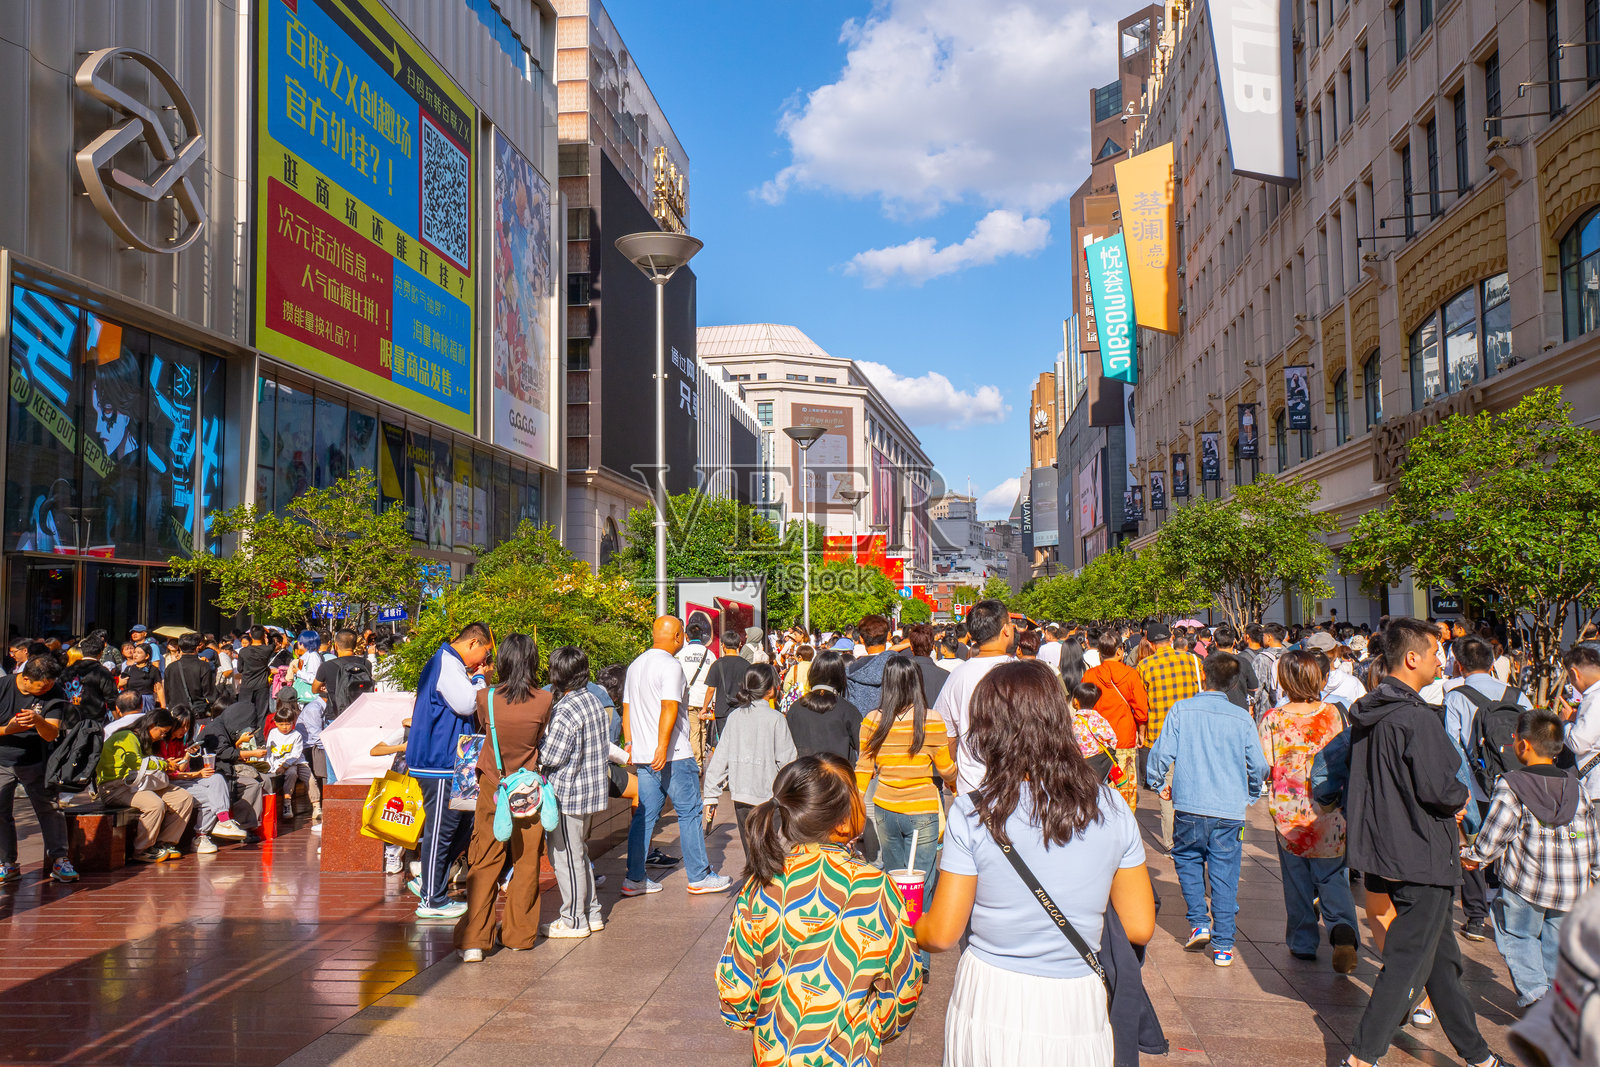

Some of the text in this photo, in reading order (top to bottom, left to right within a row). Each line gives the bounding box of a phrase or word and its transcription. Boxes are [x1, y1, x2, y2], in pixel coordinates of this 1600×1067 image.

[286, 10, 411, 159] 百联ZX创趣场
[32, 394, 76, 444] KEEP OUT
[84, 440, 101, 464] EEP
[1023, 495, 1031, 534] HUAWEI
